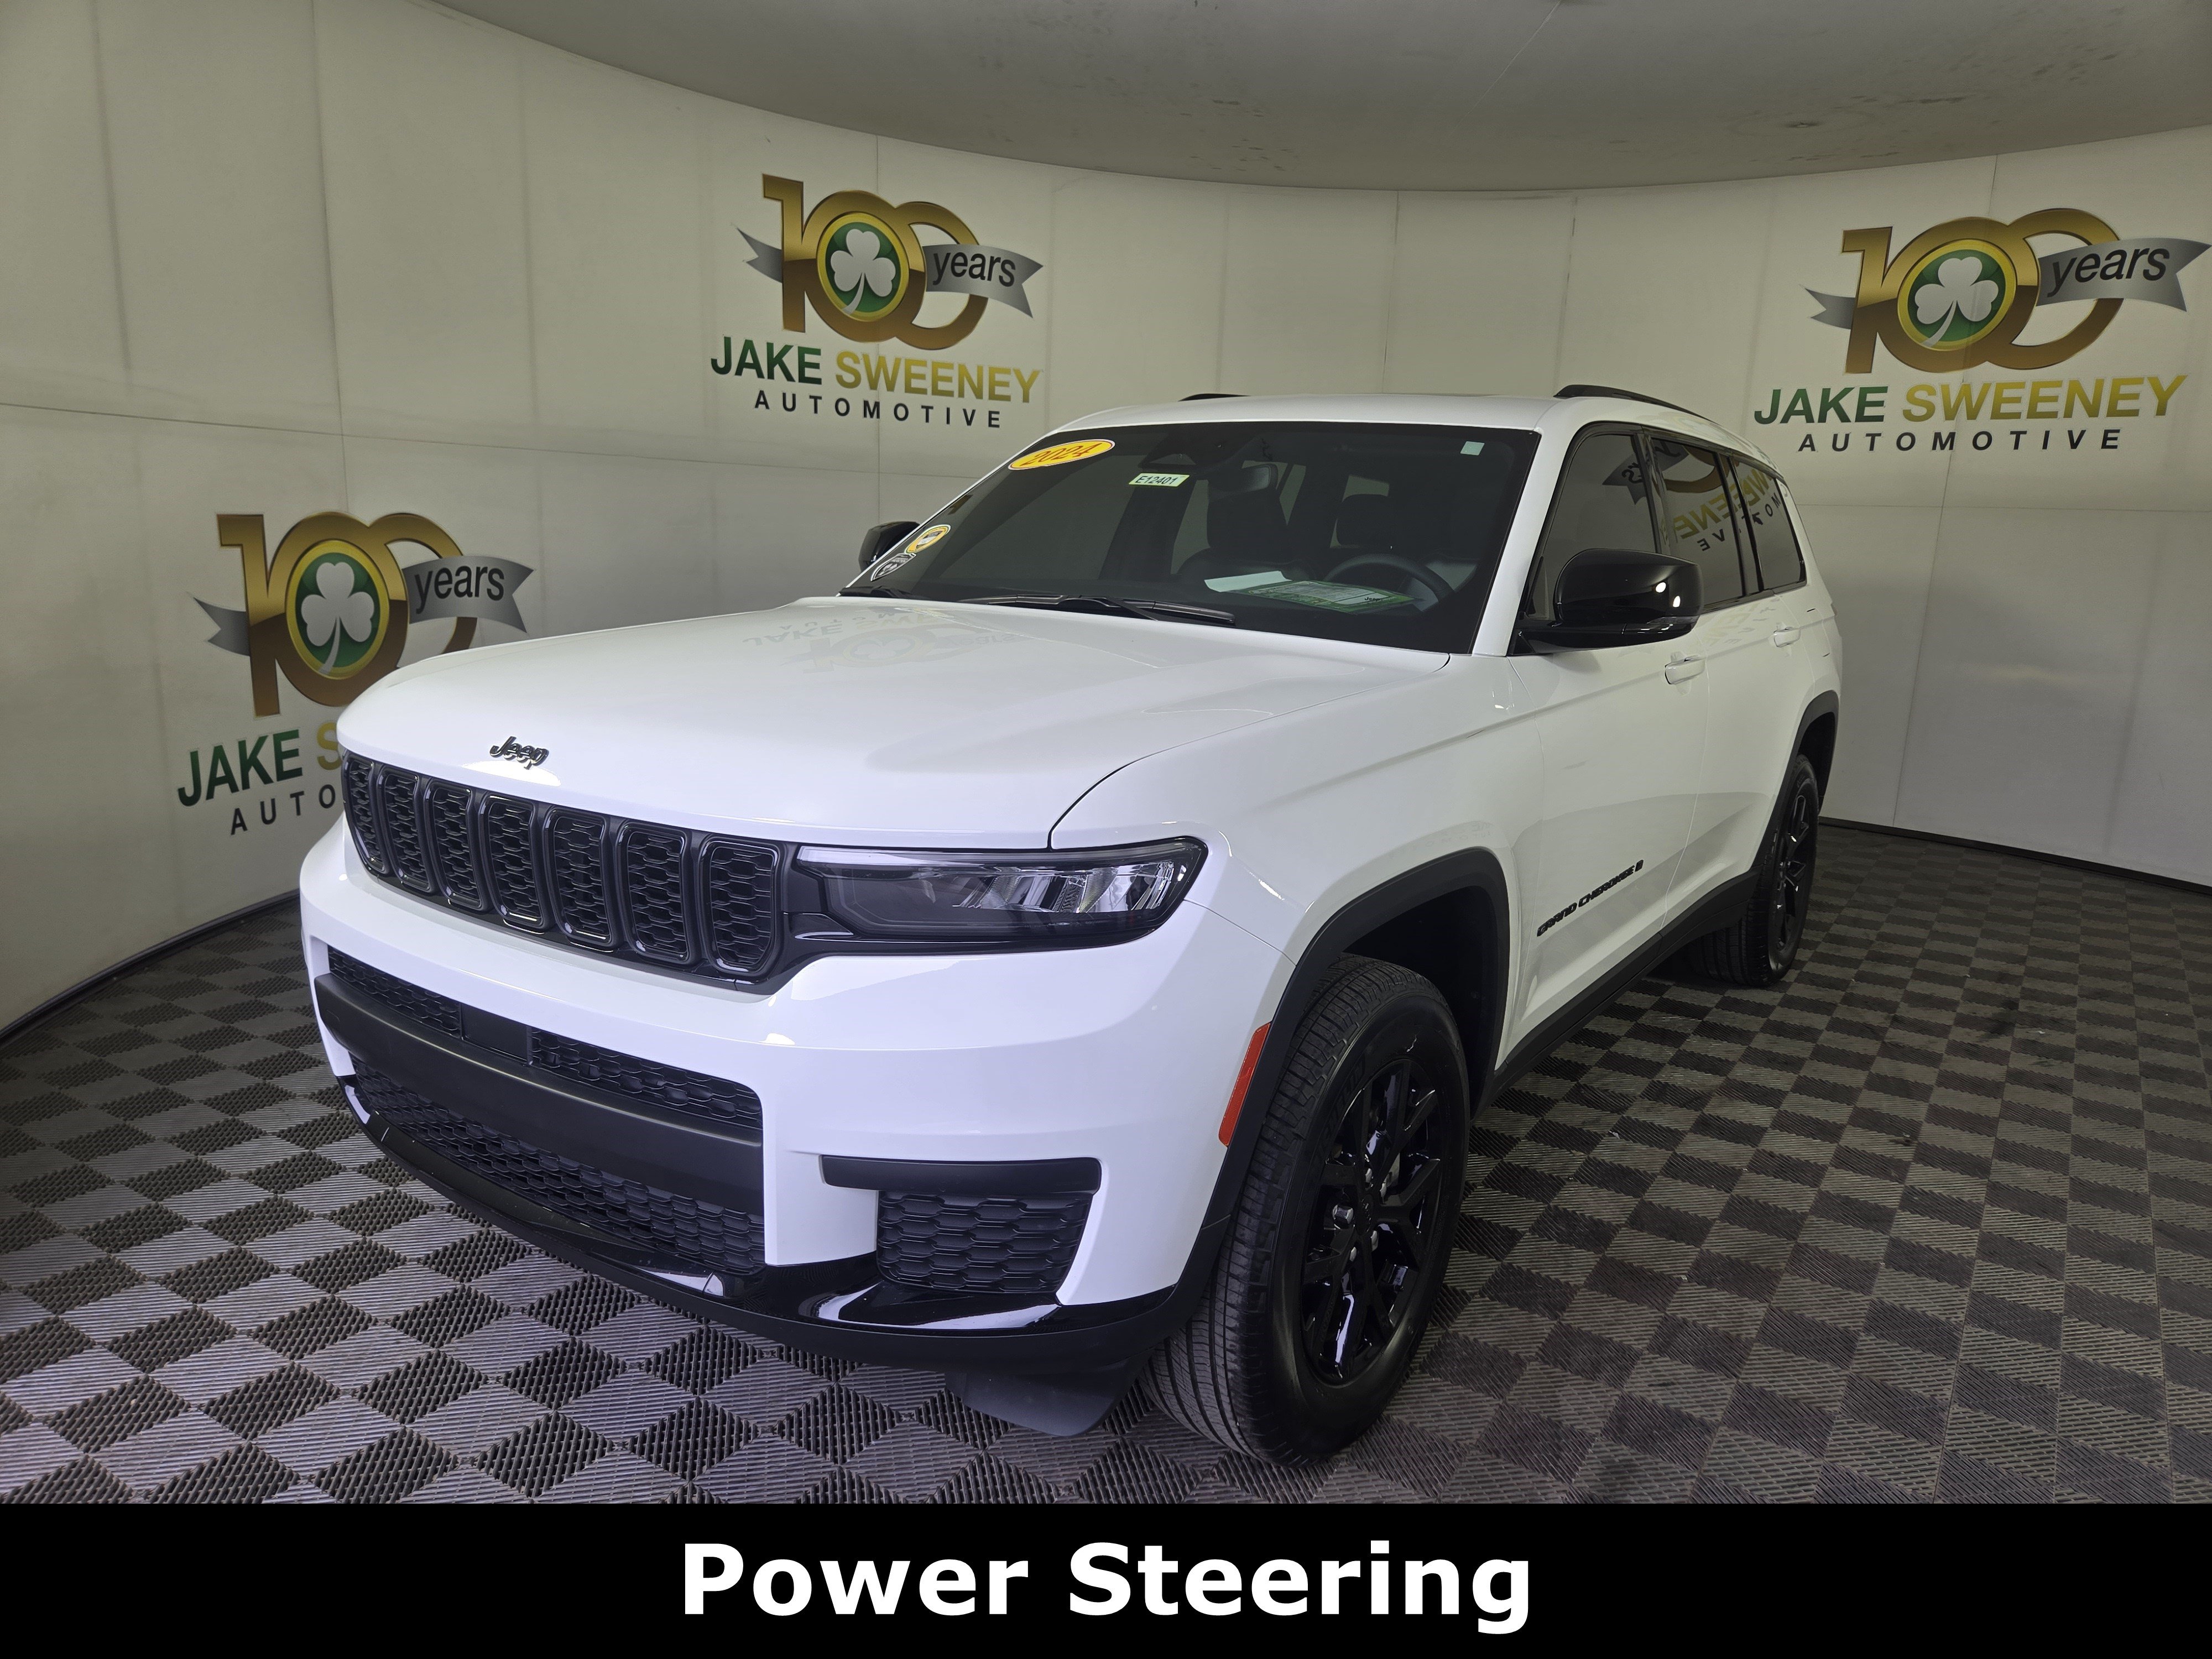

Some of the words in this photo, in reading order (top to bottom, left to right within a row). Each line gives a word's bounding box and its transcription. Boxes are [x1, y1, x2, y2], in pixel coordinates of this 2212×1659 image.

[932, 251, 1016, 288] years
[2047, 245, 2171, 298] years
[711, 336, 822, 385] JAKE
[835, 351, 1040, 403] SWEENEY
[754, 390, 1000, 429] AUTOMOTIVE
[1754, 385, 1889, 425] JAKE
[1902, 375, 2188, 422] SWEENEY
[1020, 442, 1103, 467] 2024
[1797, 429, 2121, 453] AUTOMOTIVE
[1135, 476, 1178, 485] E12401
[414, 565, 505, 614] years
[178, 729, 303, 807] JAKE
[489, 736, 549, 770] Jeep
[1537, 902, 1577, 937] GRAND
